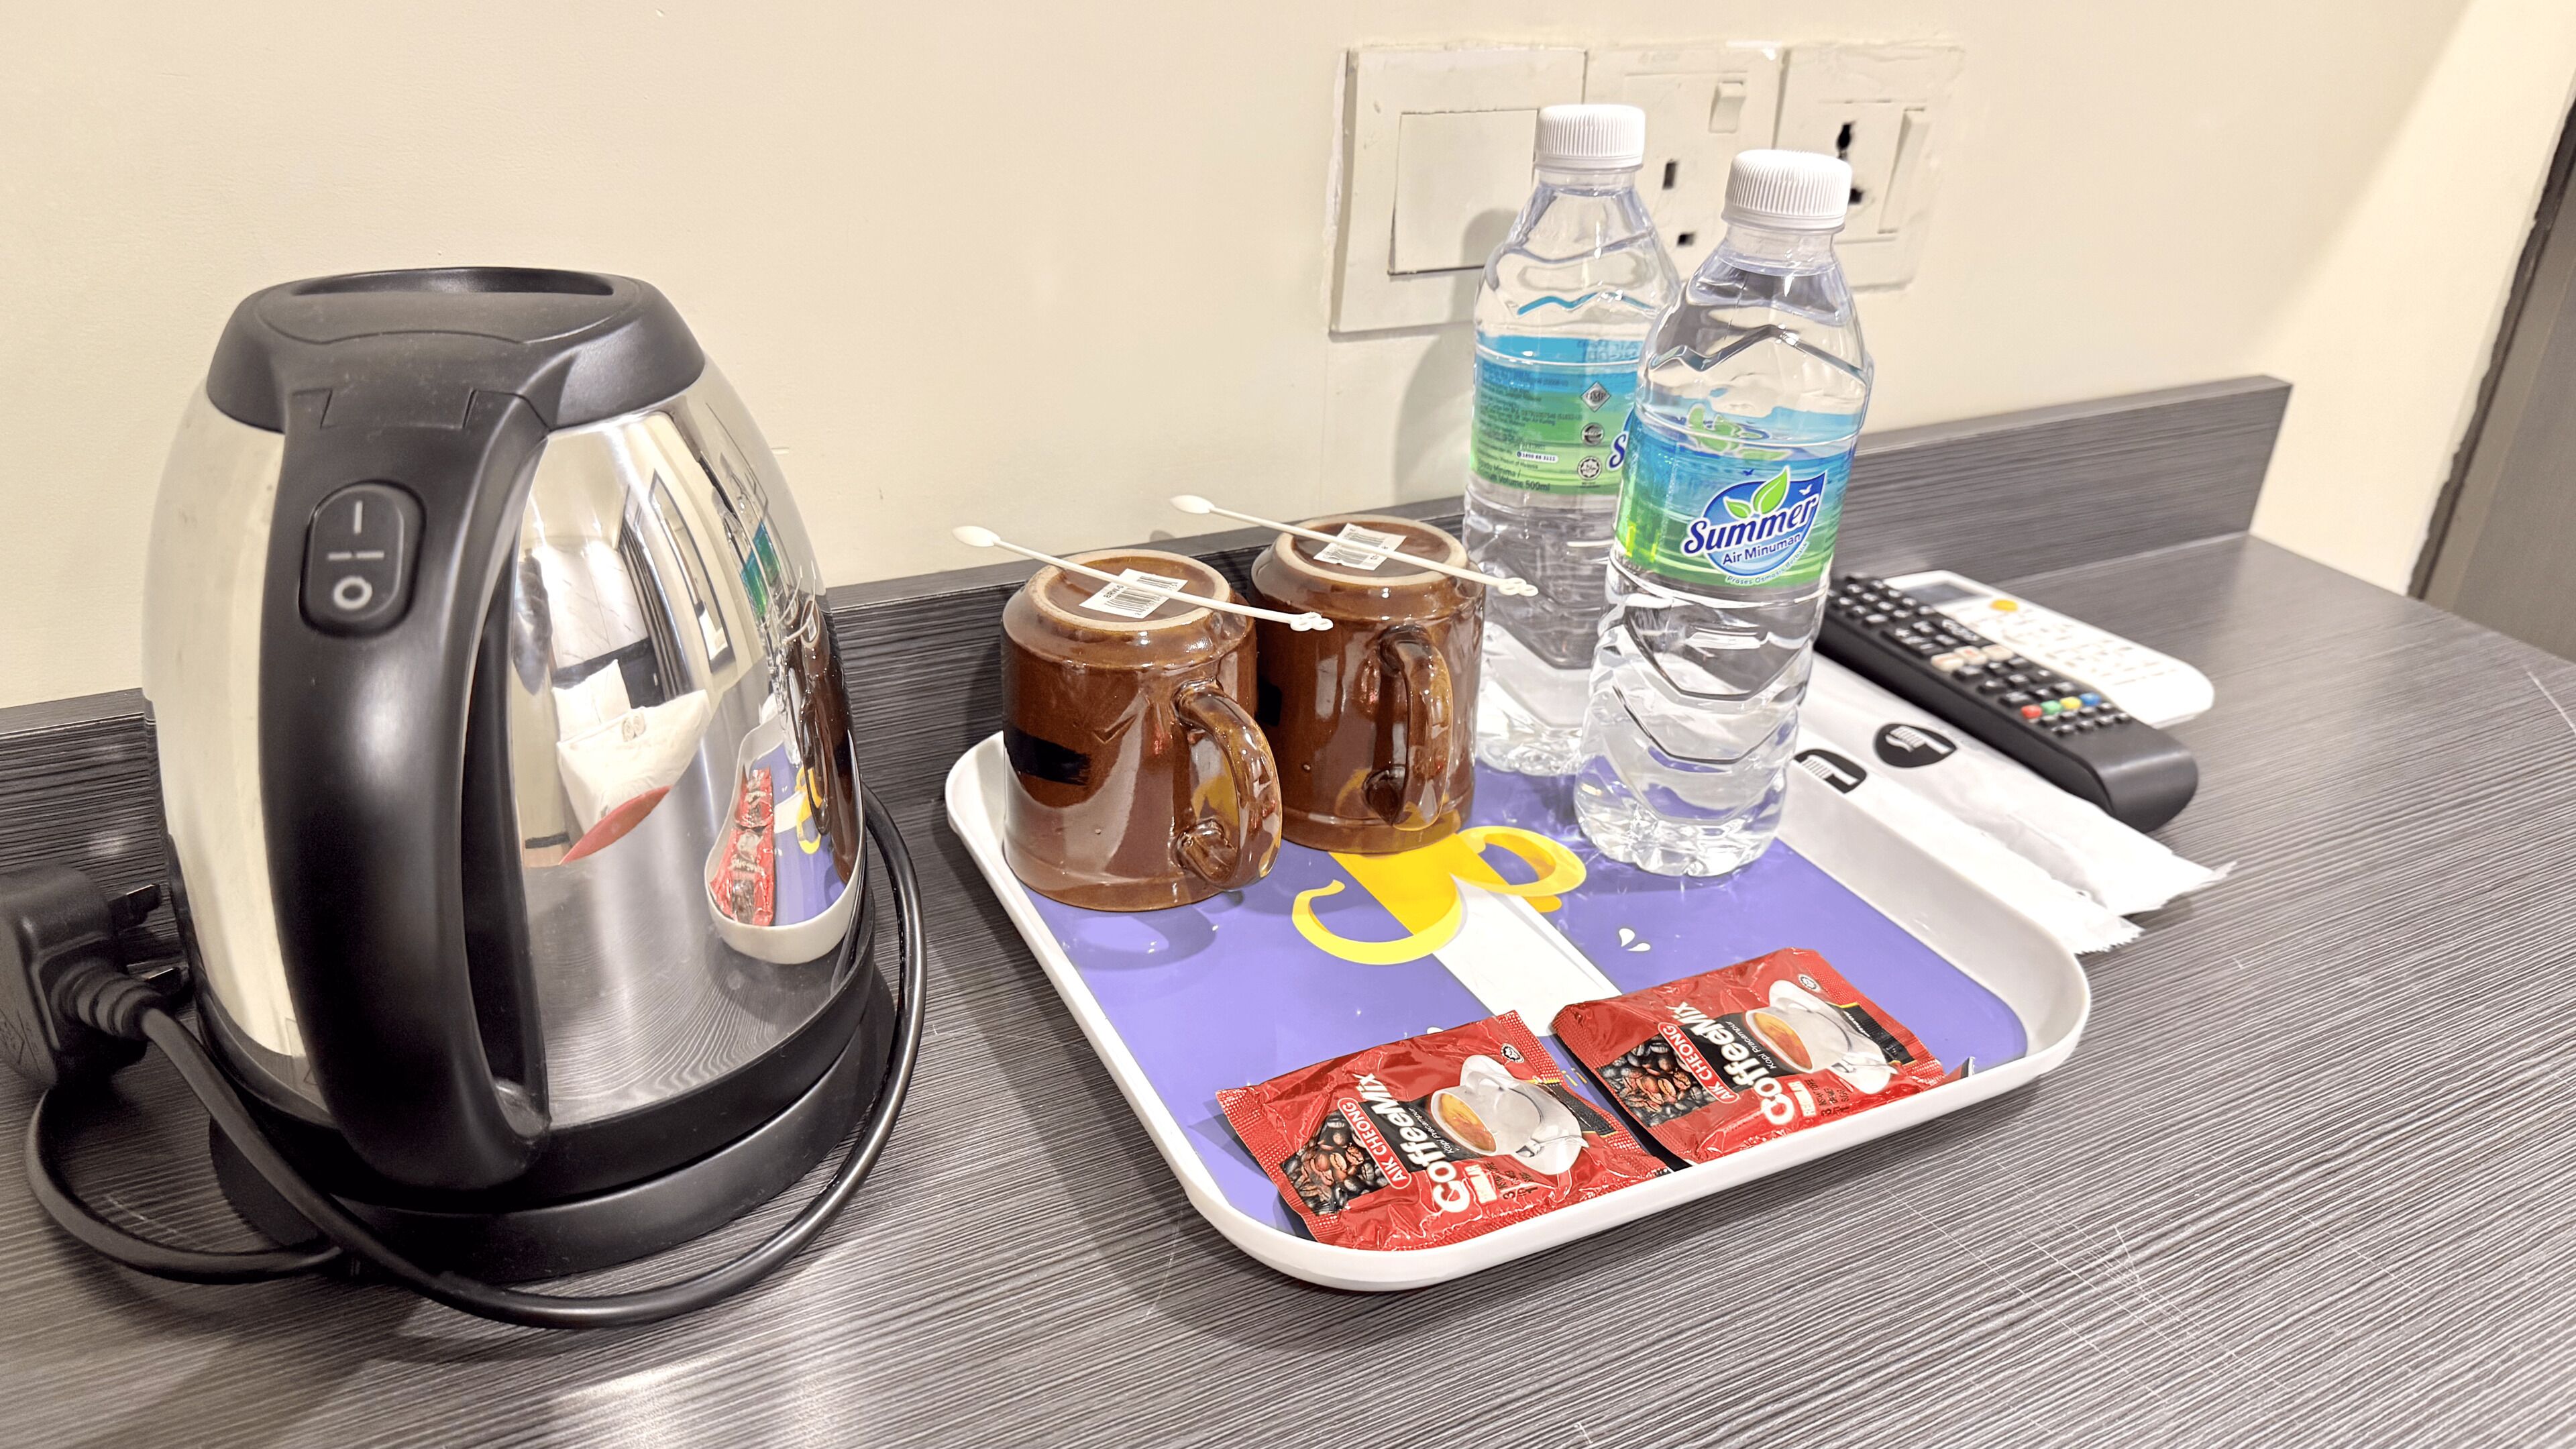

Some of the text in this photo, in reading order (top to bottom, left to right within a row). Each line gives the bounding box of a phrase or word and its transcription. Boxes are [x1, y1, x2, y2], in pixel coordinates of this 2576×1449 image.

[1525, 480, 1550, 491] 500ml
[1684, 497, 1817, 553] Summer
[1723, 533, 1801, 565] Air Minuman
[1727, 576, 1752, 584] Proses
[1755, 566, 1785, 583] Osmosis
[1662, 1025, 1735, 1099] AIK CHEONG
[1666, 1002, 1794, 1125] CoffeeMix
[1725, 1021, 1777, 1069] Kopi Pracampur
[1342, 1102, 1407, 1182] AIK CHEONG
[1352, 1073, 1470, 1213] CoffeeMix
[1438, 1139, 1455, 1154] Kopi
